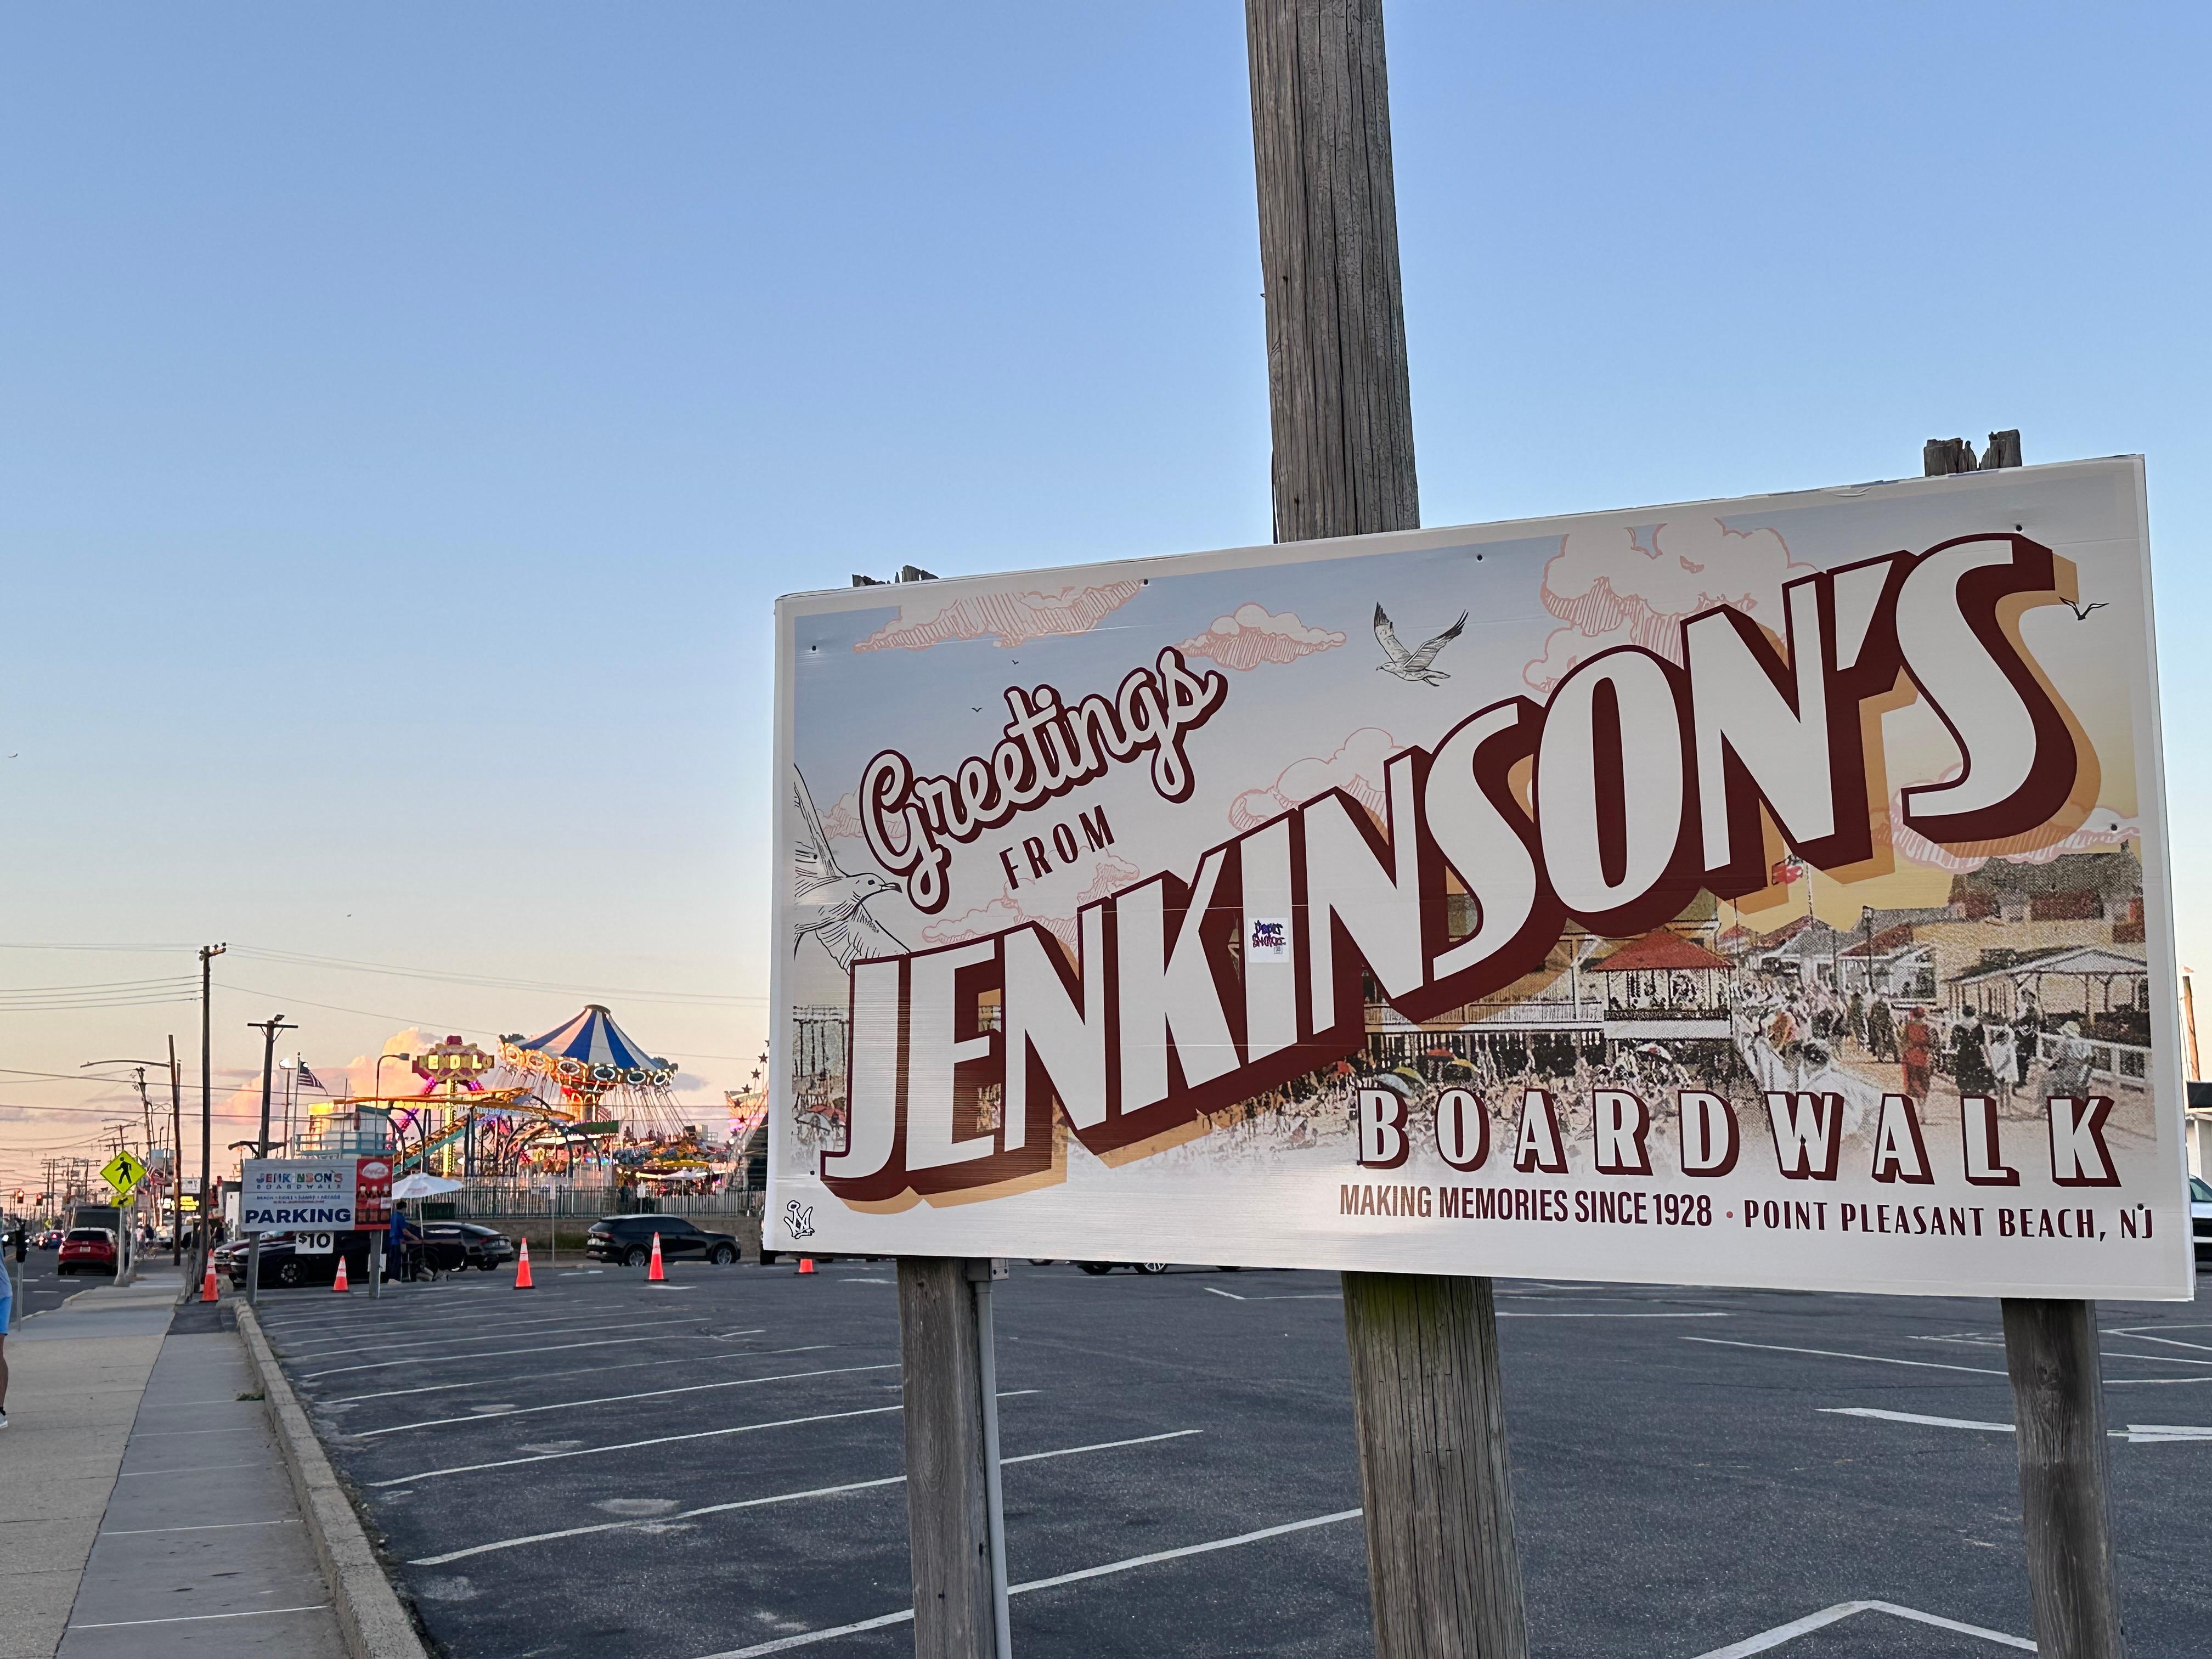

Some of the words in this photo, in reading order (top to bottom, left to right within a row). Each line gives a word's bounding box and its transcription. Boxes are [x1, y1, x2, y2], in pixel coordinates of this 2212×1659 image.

[859, 646, 1229, 915] Greetings
[821, 532, 2085, 1205] JENKINSON'S
[998, 804, 1115, 890] FROM
[1357, 1087, 2122, 1187] BOARDWALK
[245, 1208, 352, 1224] PARKING
[298, 1232, 331, 1249] $10
[1340, 1184, 1432, 1218] MAKING
[1439, 1186, 1568, 1222] MEMORIES
[1574, 1189, 1647, 1225] SINCE
[1652, 1193, 1713, 1227] 1928
[1744, 1199, 1828, 1231] POINT
[1841, 1203, 1985, 1238] PLEASANT
[1999, 1208, 2106, 1242] BEACH,
[2120, 1208, 2153, 1239] NJ
